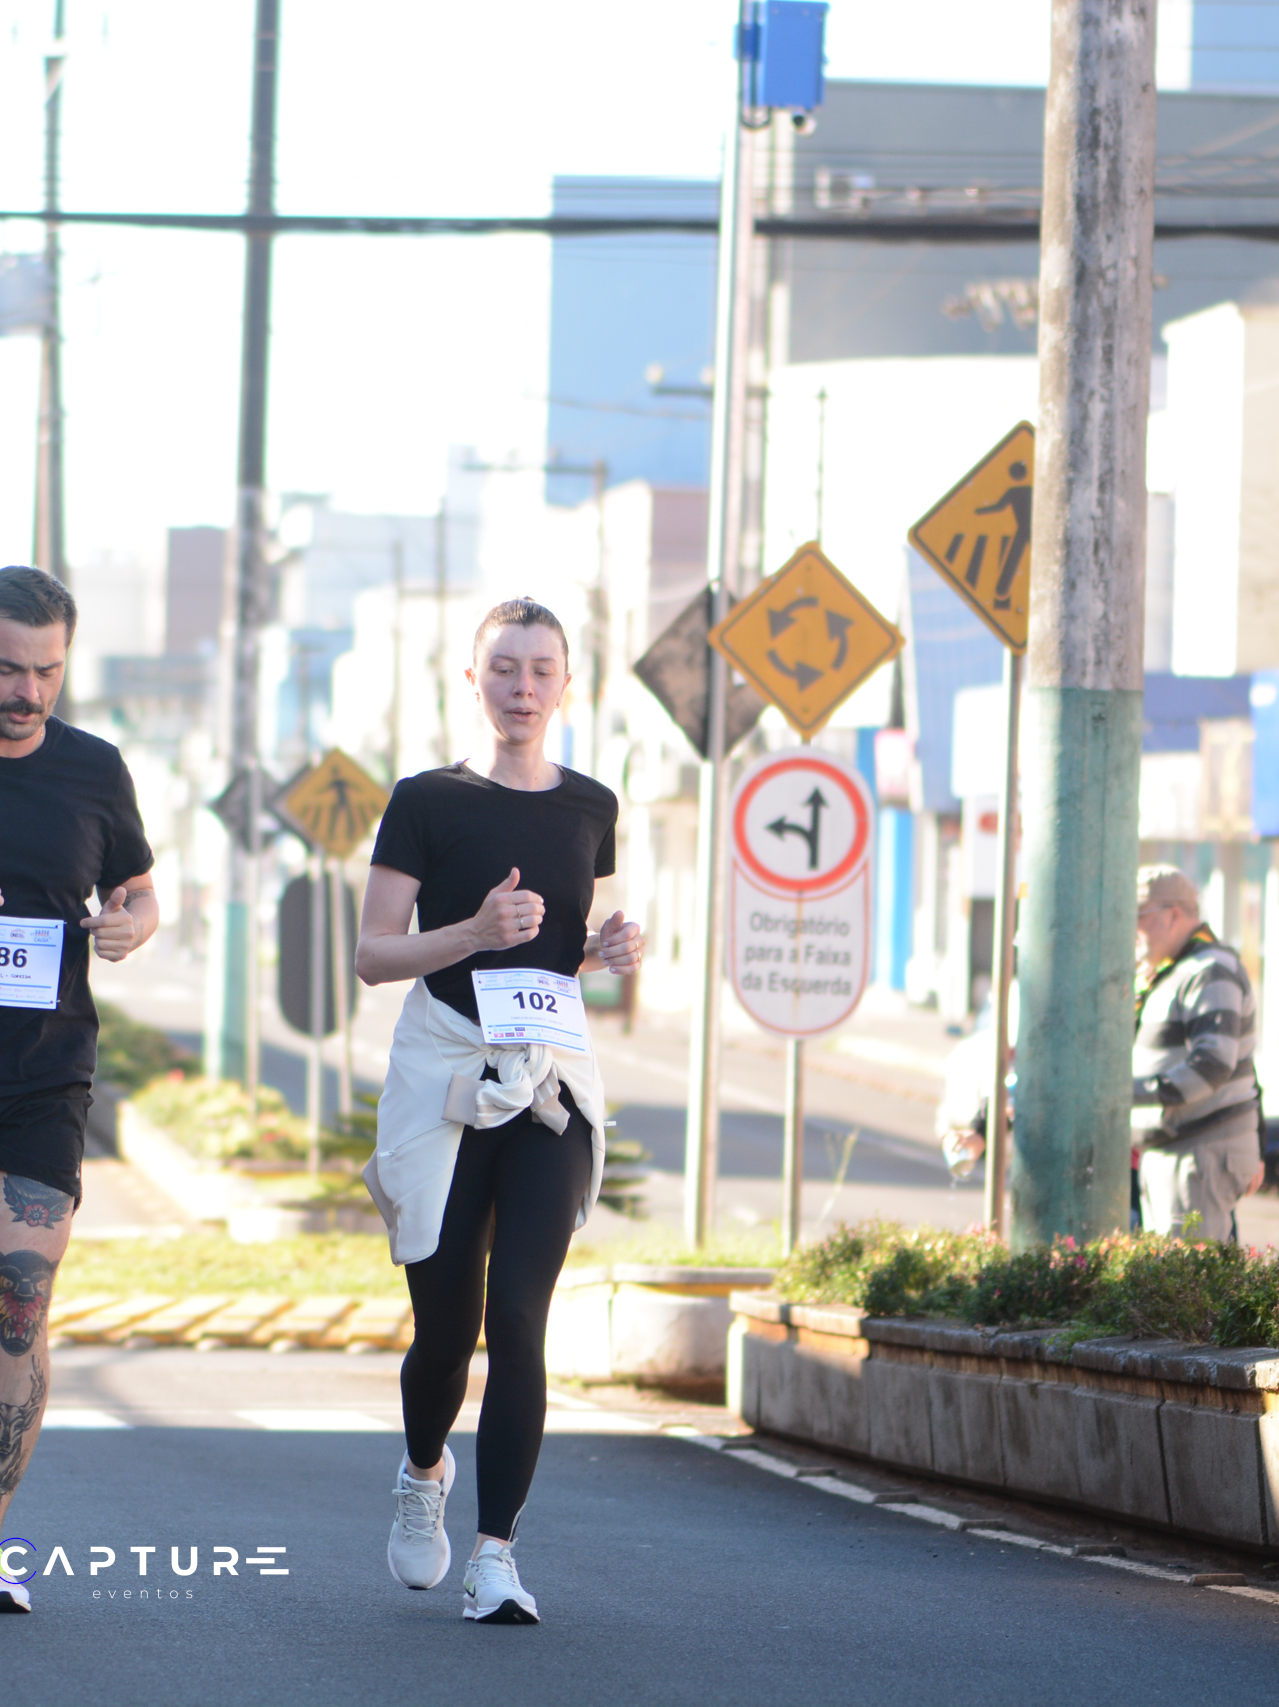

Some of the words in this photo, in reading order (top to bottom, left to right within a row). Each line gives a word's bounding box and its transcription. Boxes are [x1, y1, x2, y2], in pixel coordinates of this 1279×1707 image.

[749, 911, 850, 939] Obrigatório
[745, 946, 783, 966] para
[788, 948, 799, 963] a
[804, 944, 851, 966] Faixa
[741, 971, 762, 991] da
[767, 971, 852, 998] Esquerda
[513, 991, 558, 1014] 102
